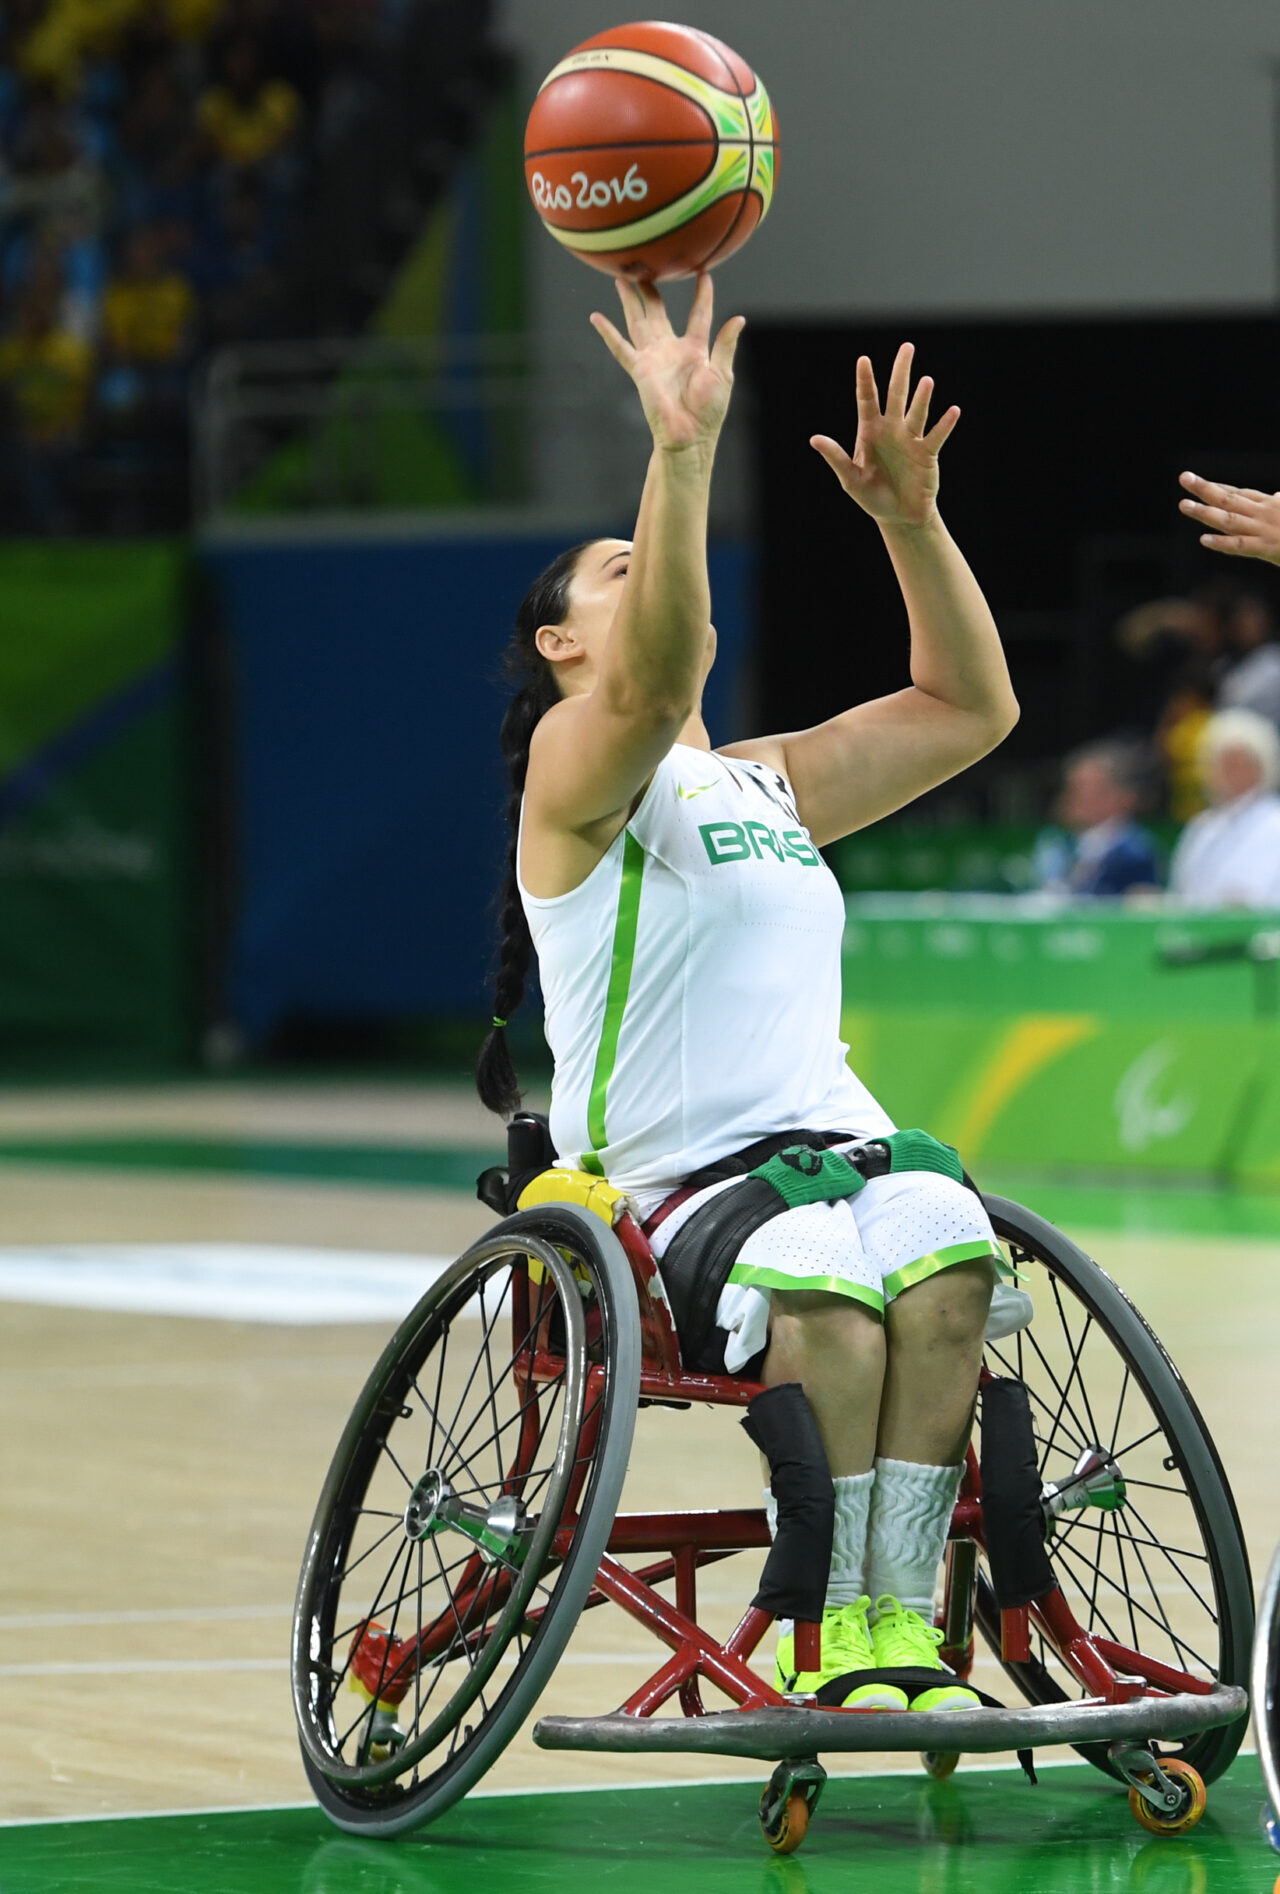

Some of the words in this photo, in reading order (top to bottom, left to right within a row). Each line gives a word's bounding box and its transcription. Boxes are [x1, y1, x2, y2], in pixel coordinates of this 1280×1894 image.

[532, 171, 572, 211] Rio
[571, 163, 648, 210] 2016
[698, 821, 826, 867] BRAS
